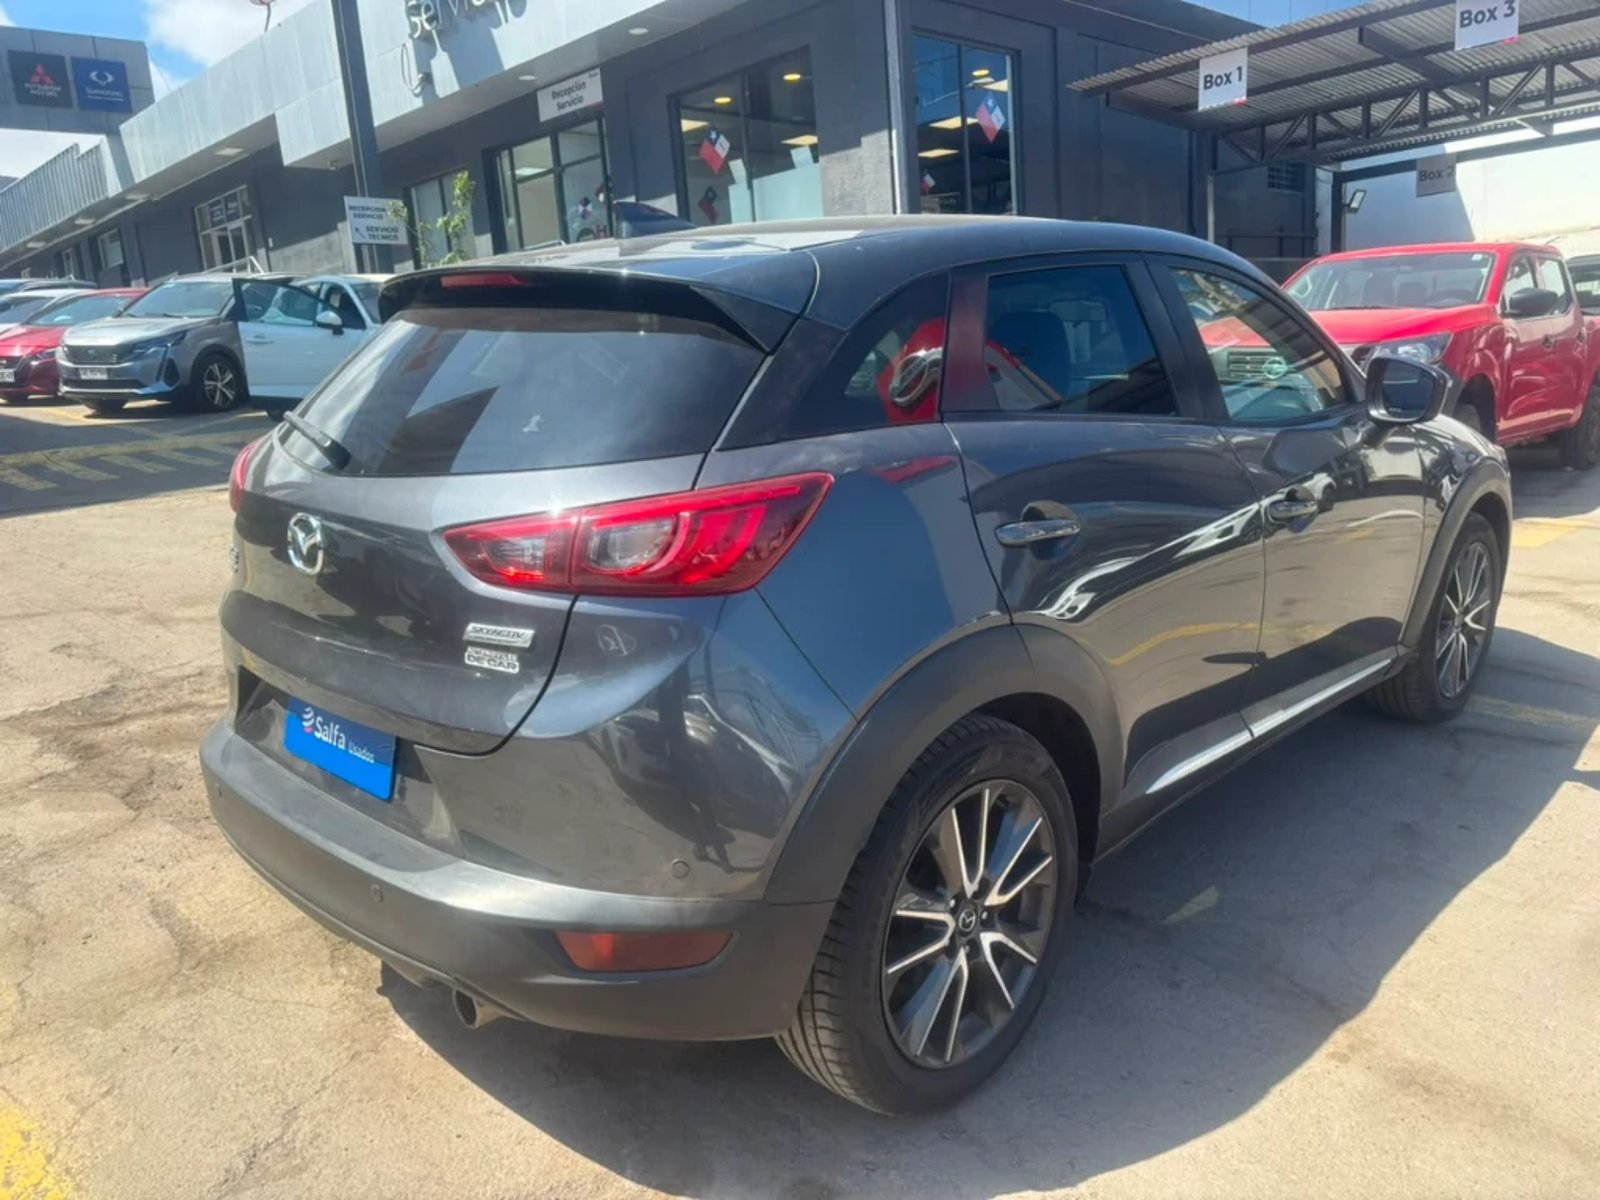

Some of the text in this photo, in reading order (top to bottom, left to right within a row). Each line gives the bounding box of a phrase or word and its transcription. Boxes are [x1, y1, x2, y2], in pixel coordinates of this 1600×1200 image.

[1459, 0, 1516, 29] Box 3
[1203, 66, 1243, 90] Box 1
[551, 80, 587, 100] Recepción
[556, 93, 584, 112] Servicio
[1419, 168, 1444, 182] Box
[314, 715, 347, 751] Salfa
